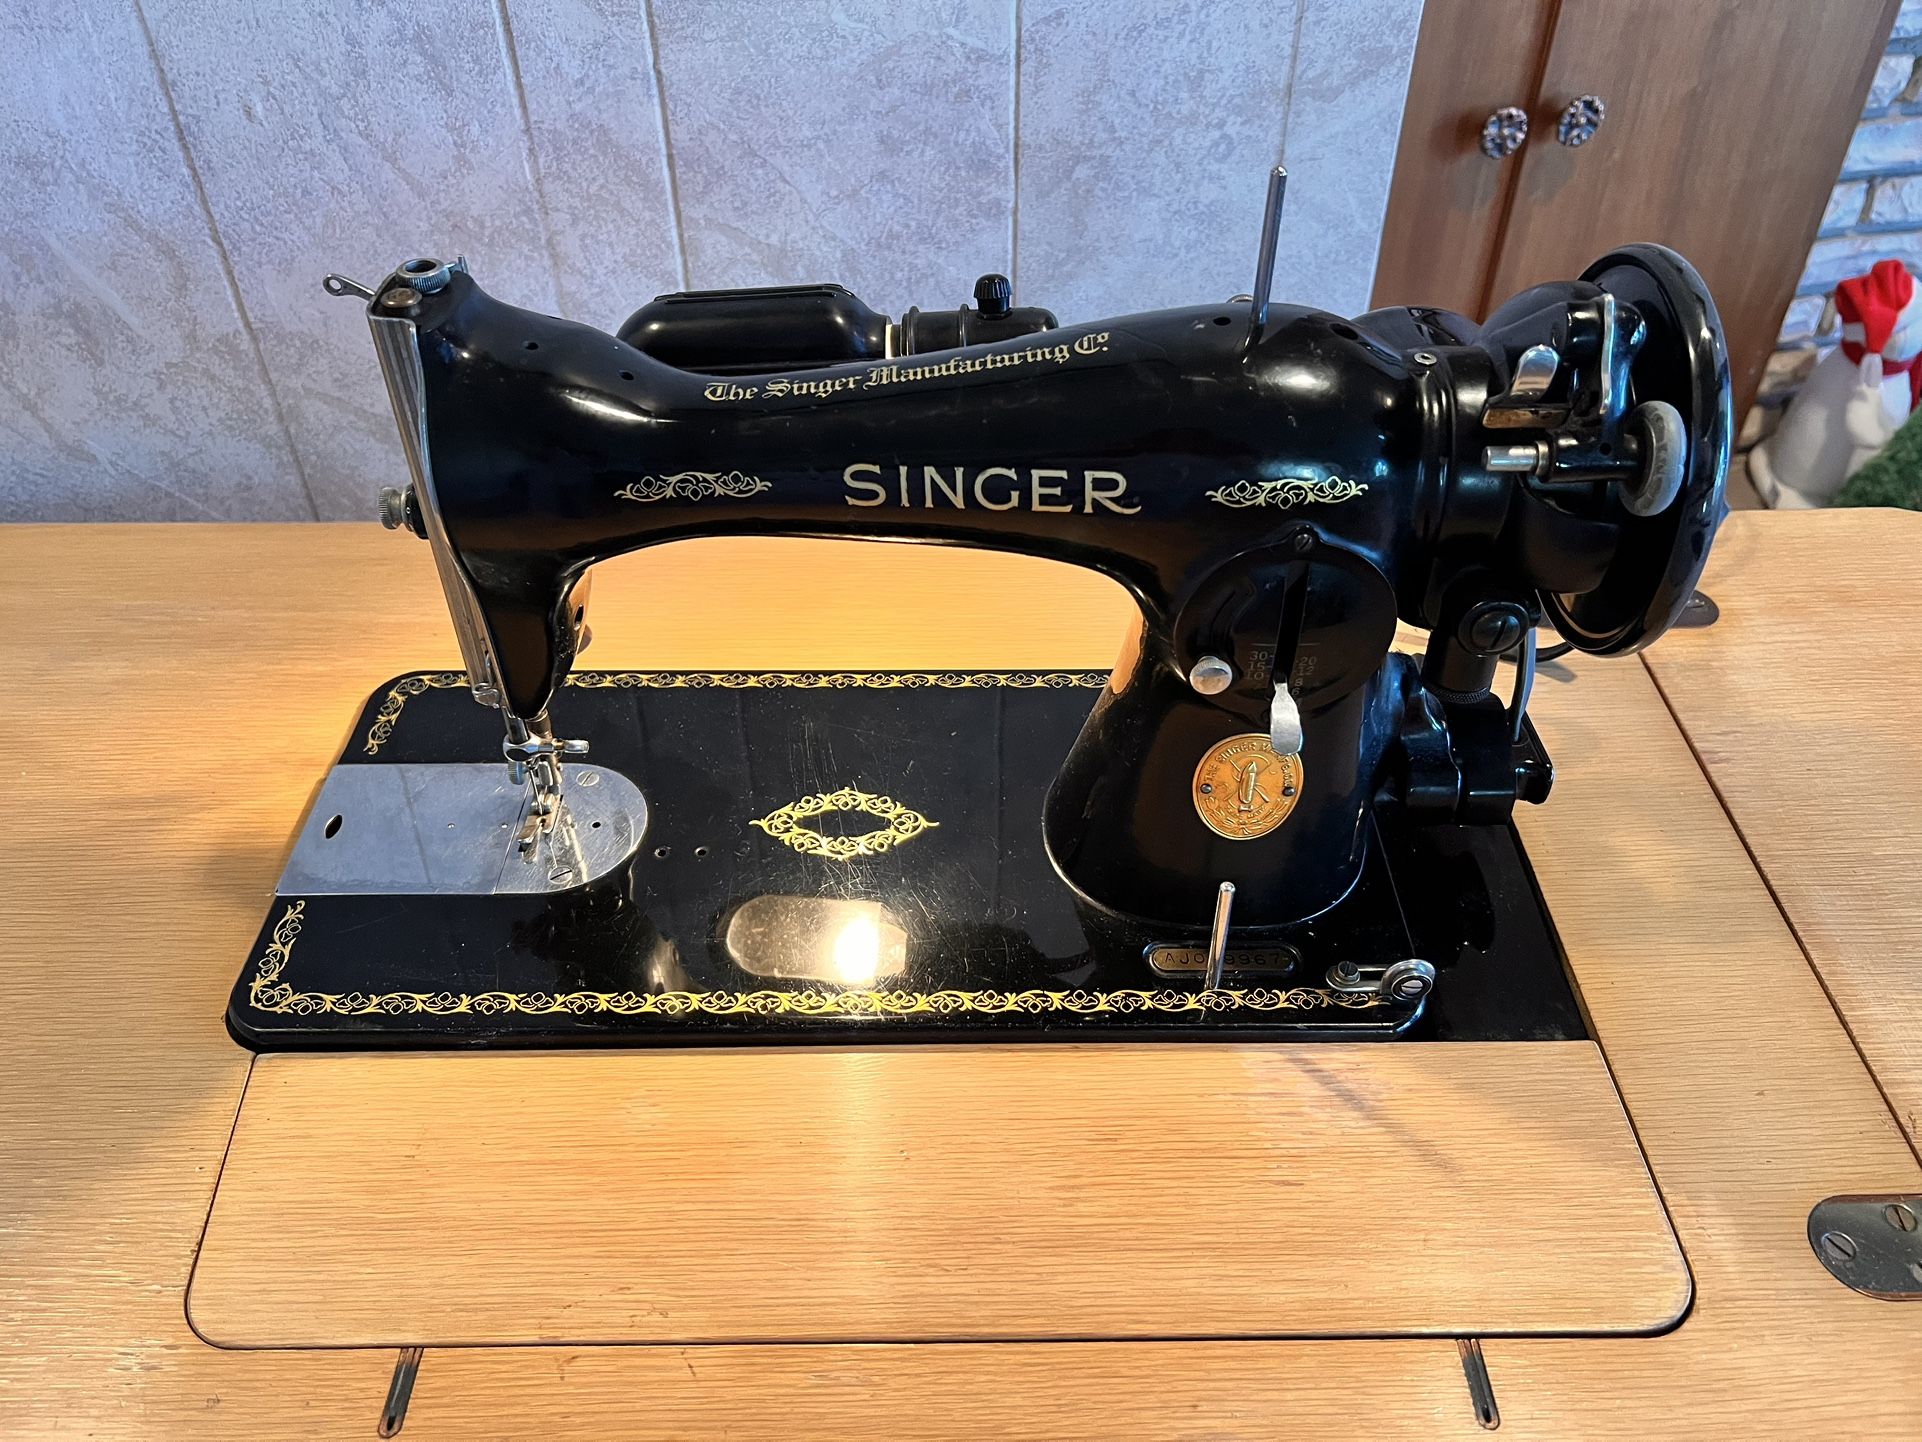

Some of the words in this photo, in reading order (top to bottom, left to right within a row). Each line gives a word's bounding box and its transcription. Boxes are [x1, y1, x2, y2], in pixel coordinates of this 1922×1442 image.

[703, 381, 759, 402] The
[763, 374, 863, 399] Singer
[863, 344, 1070, 388] Manufacturing
[842, 462, 1143, 516] SINGER
[1249, 651, 1268, 660] 30
[1300, 656, 1317, 666] 20
[1248, 661, 1265, 671] 15
[1215, 742, 1257, 763] SINGER
